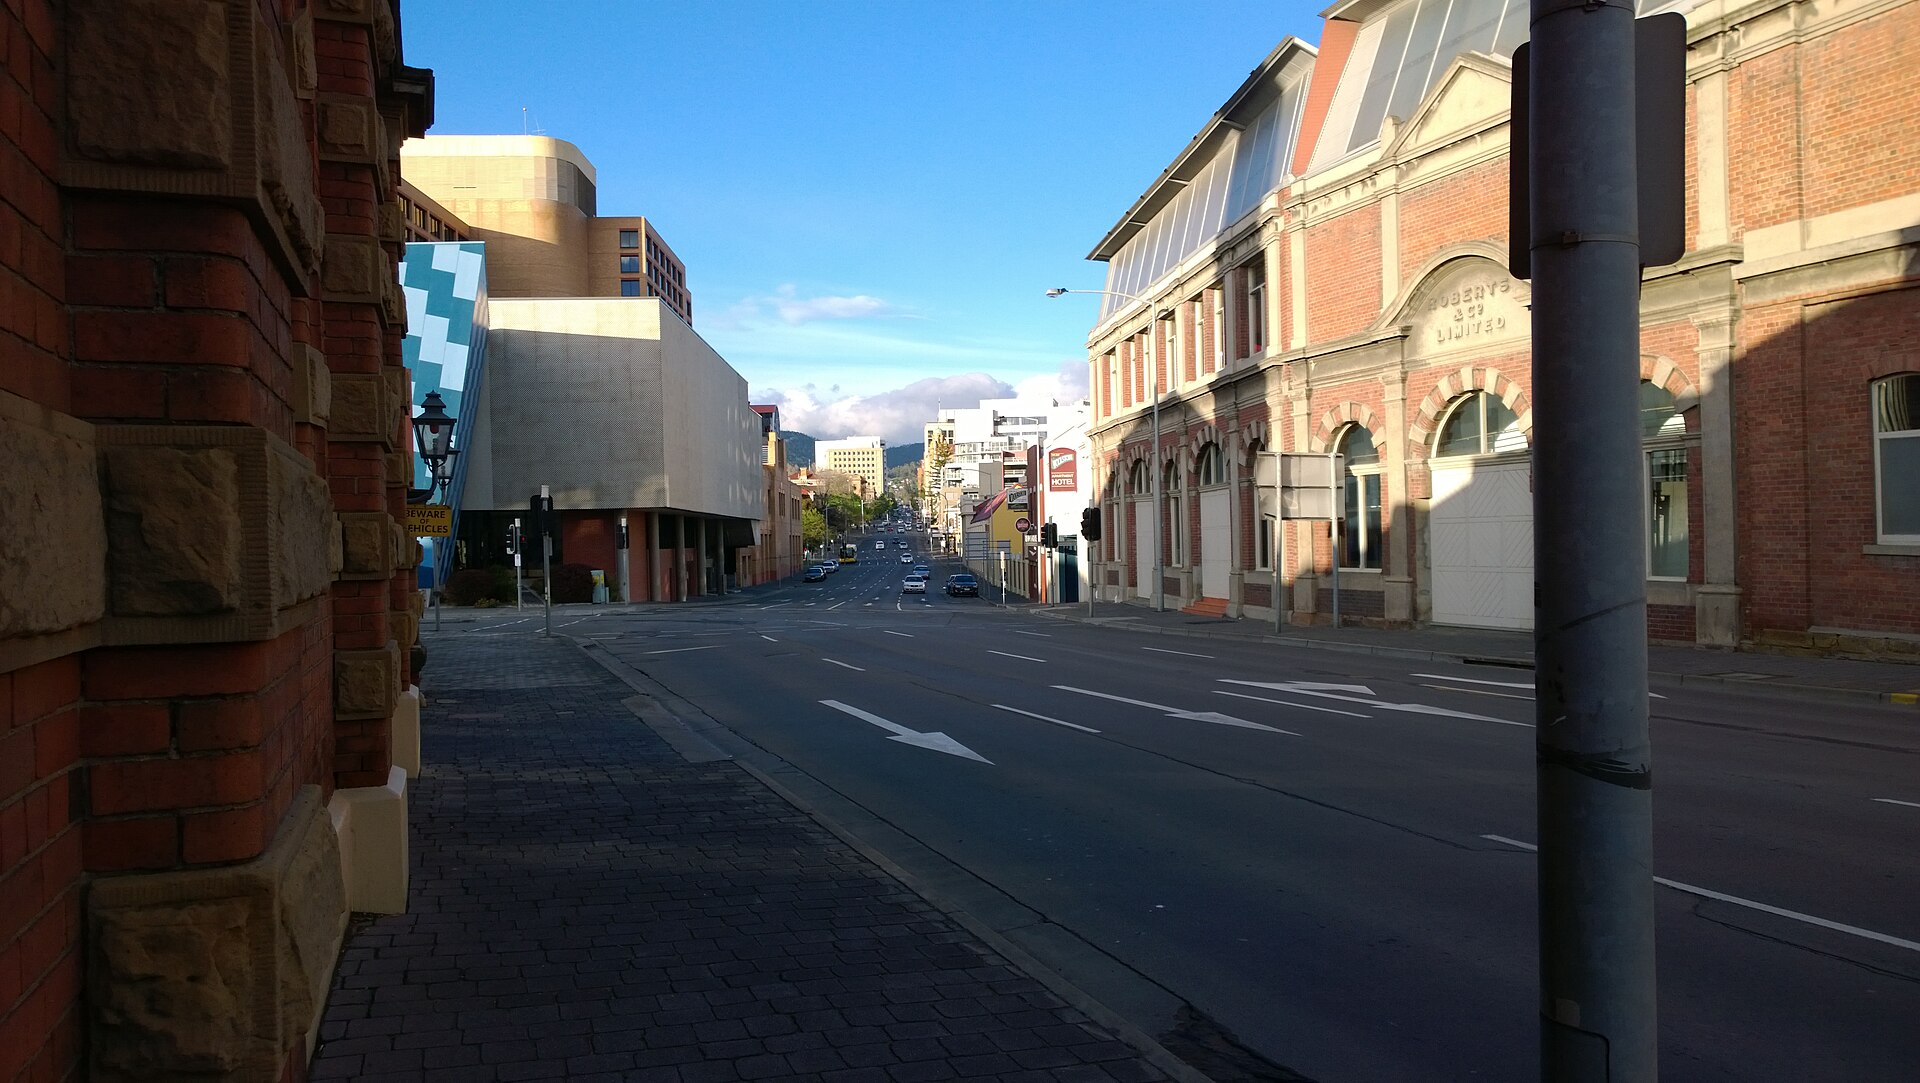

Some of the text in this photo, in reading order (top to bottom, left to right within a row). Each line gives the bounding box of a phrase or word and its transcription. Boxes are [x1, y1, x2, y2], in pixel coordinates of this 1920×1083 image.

[1427, 278, 1510, 311] ROBERTS
[1437, 315, 1506, 342] LIMITED
[1051, 478, 1075, 486] HOTEL
[406, 510, 445, 518] BEWARE
[408, 524, 448, 533] EHICLES
